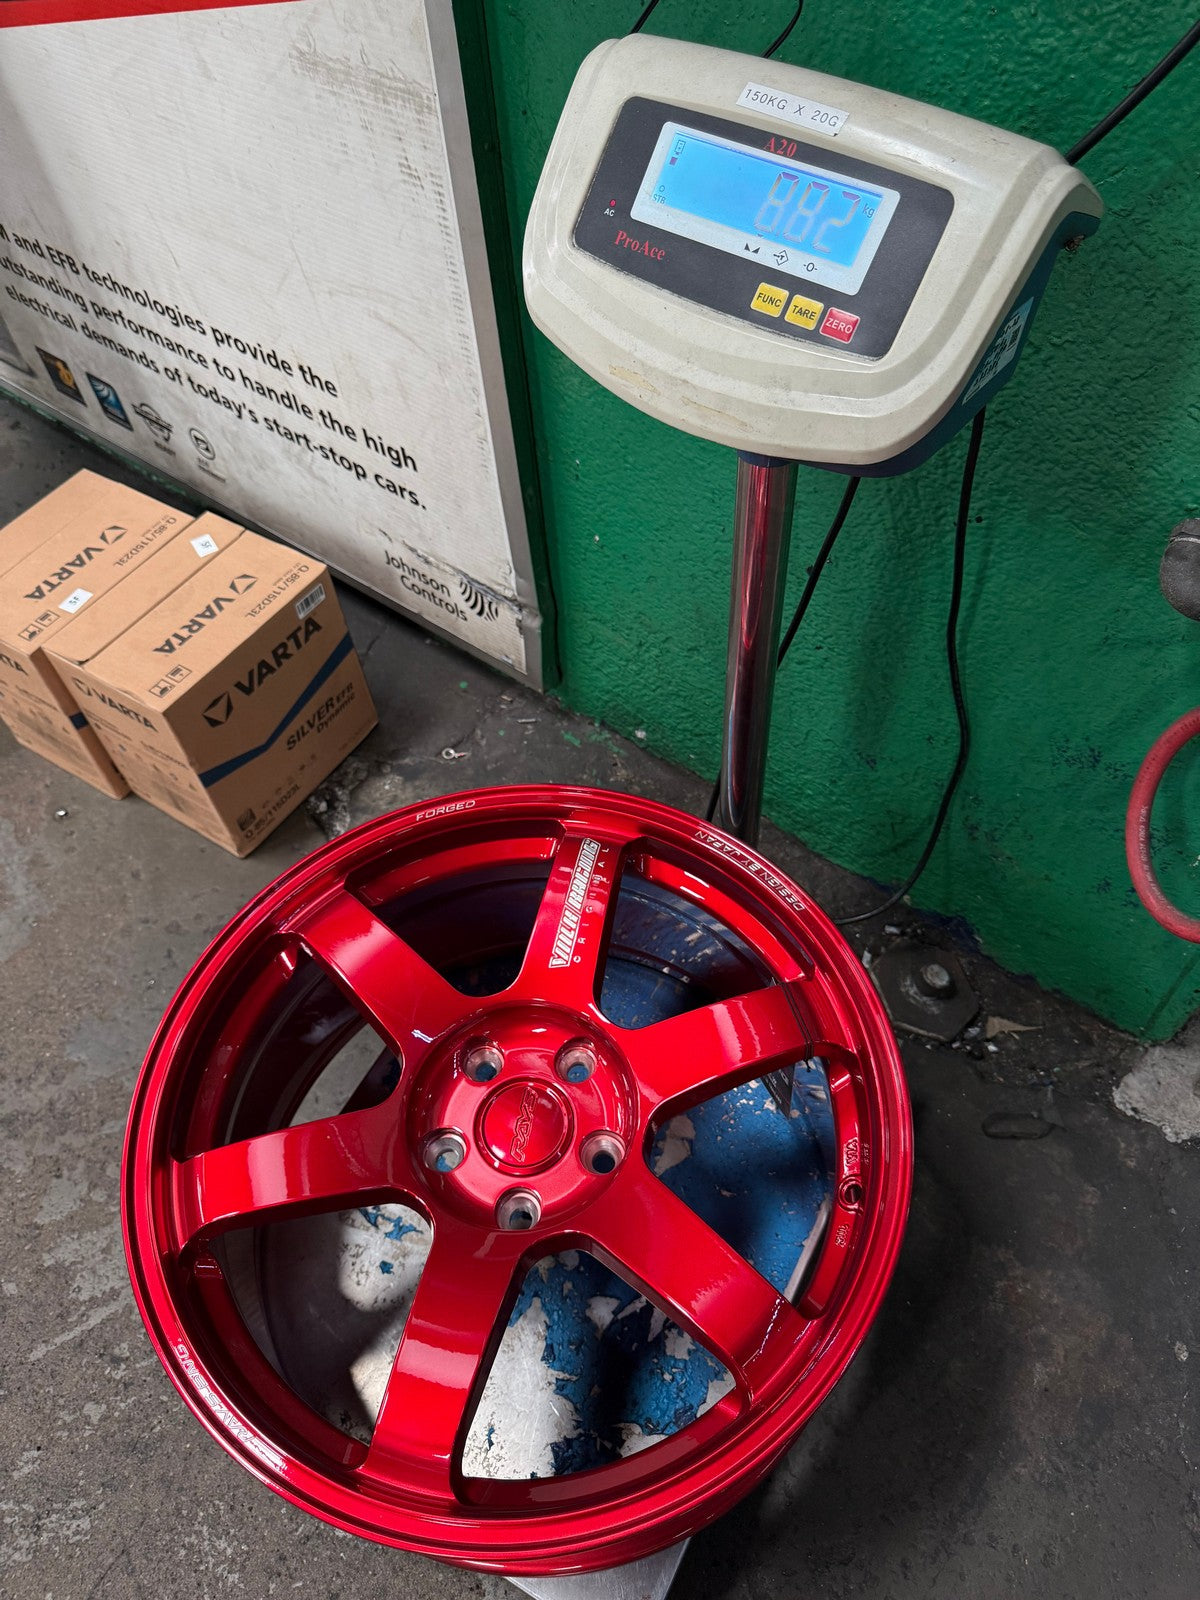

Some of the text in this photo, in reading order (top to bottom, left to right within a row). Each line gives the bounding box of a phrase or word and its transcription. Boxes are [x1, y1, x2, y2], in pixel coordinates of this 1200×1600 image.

[744, 89, 839, 128] 150KG X 20G
[763, 136, 797, 158] A20
[603, 207, 615, 217] AC
[653, 193, 667, 205] STB
[862, 203, 875, 219] kg
[614, 229, 666, 261] ProAce
[12, 232, 46, 260] and
[45, 244, 80, 276] EFB
[82, 262, 207, 336] technologies
[211, 326, 294, 378] provide
[298, 364, 338, 398] the
[756, 292, 782, 308] FUNC
[792, 304, 817, 321] TARE
[826, 318, 853, 334] ZERO
[0, 254, 418, 473] utstanding performance to handle the high
[5, 284, 78, 332] electrical
[81, 322, 160, 374] demands
[164, 367, 183, 387] of
[188, 374, 259, 424] today's
[264, 416, 367, 481] start-stop
[374, 473, 427, 511] cars.
[24, 547, 105, 600] VARTA
[385, 550, 450, 597] Johnson
[401, 575, 468, 622] Controls
[153, 596, 236, 655] VARTA
[234, 617, 322, 697] VARTA
[91, 687, 159, 733] VARTA
[286, 697, 336, 751] SILVER
[416, 800, 476, 821] FORGED
[695, 831, 805, 911] DESIGN BY JAPAN
